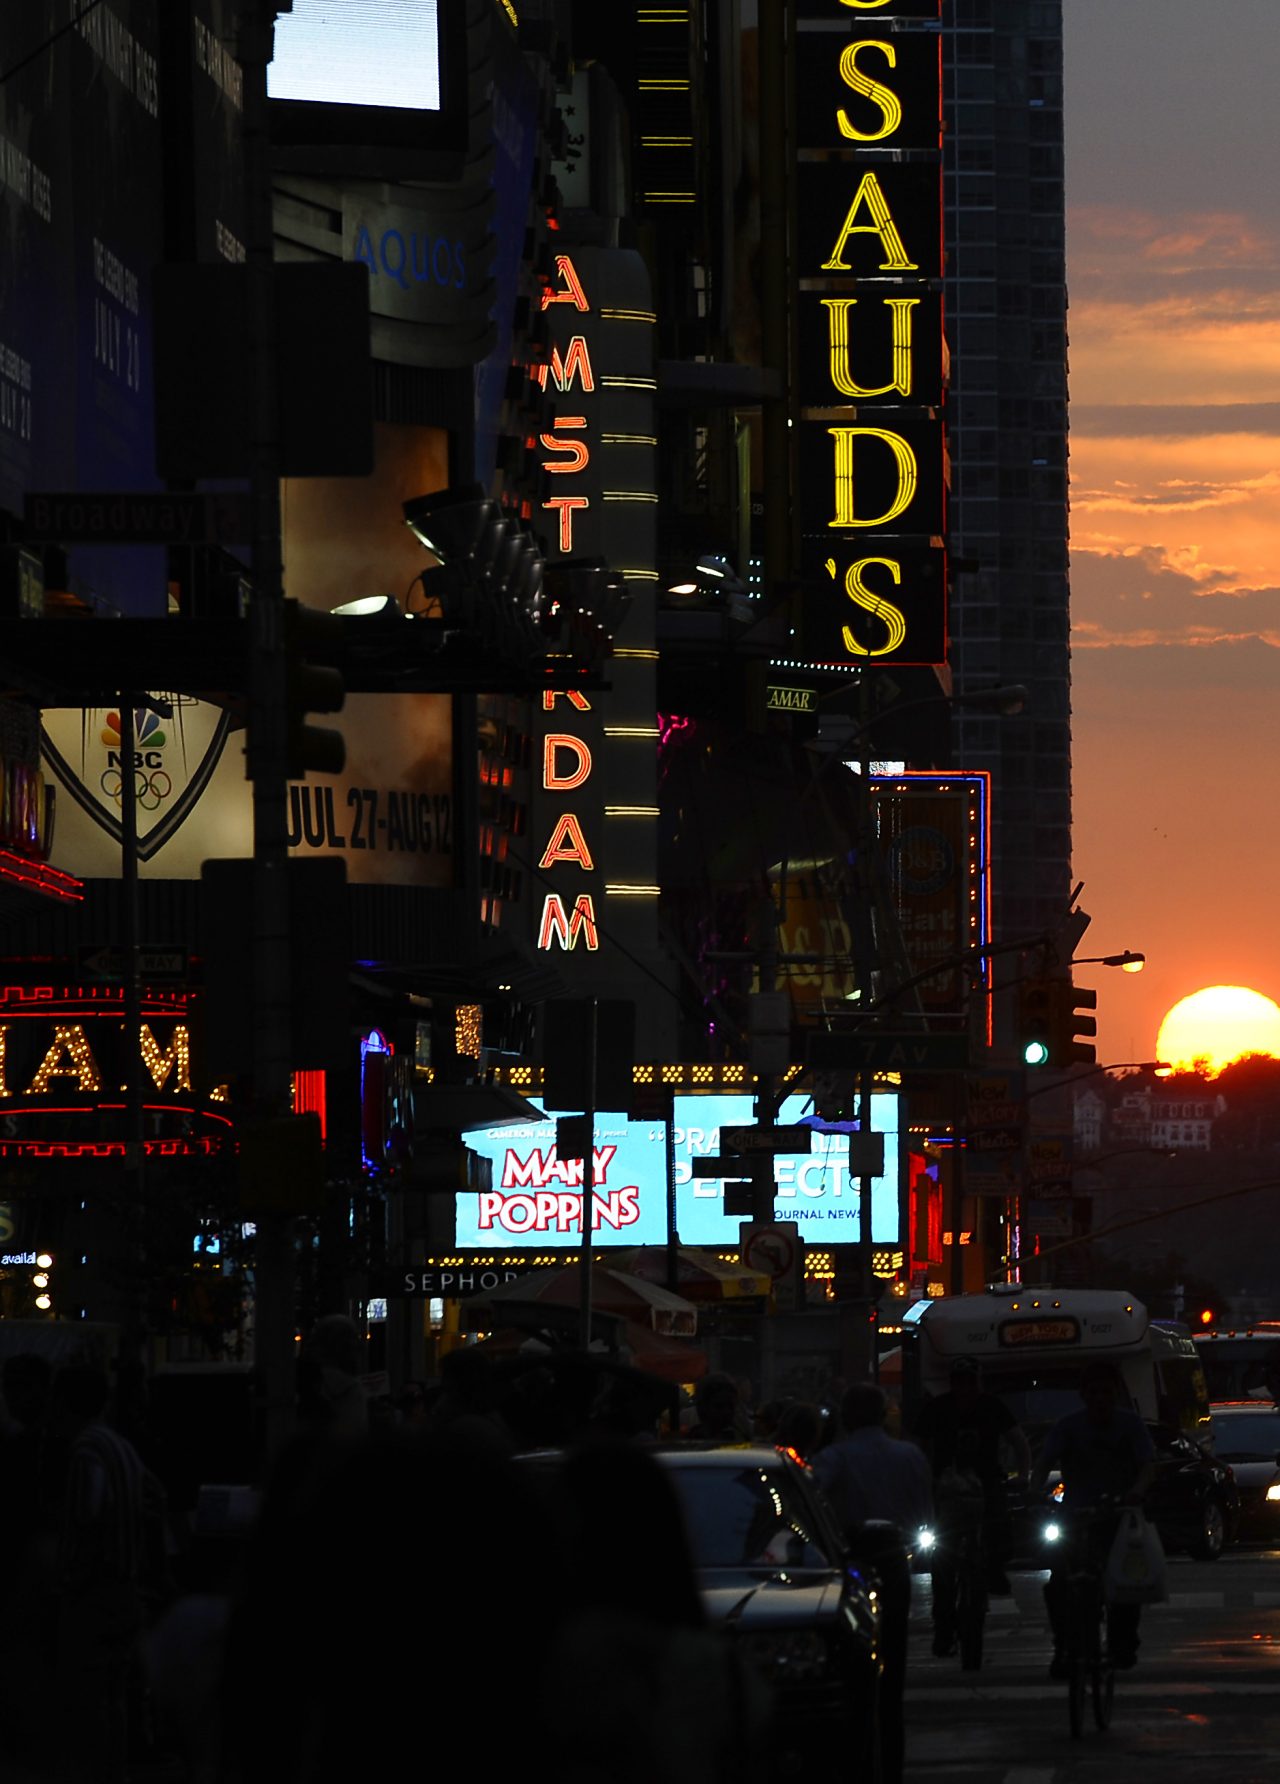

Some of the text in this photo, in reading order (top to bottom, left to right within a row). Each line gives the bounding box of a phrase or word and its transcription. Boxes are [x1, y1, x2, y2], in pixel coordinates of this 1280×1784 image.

[355, 224, 466, 290] AQUOS
[820, 0, 921, 656] SAUD'S
[31, 496, 194, 540] Broadway
[286, 785, 346, 848] JUL
[734, 1133, 760, 1147] ONE
[478, 1186, 641, 1233] POPPINS
[774, 1209, 825, 1220] OURNAL
[403, 1271, 530, 1293] SEPHOR
